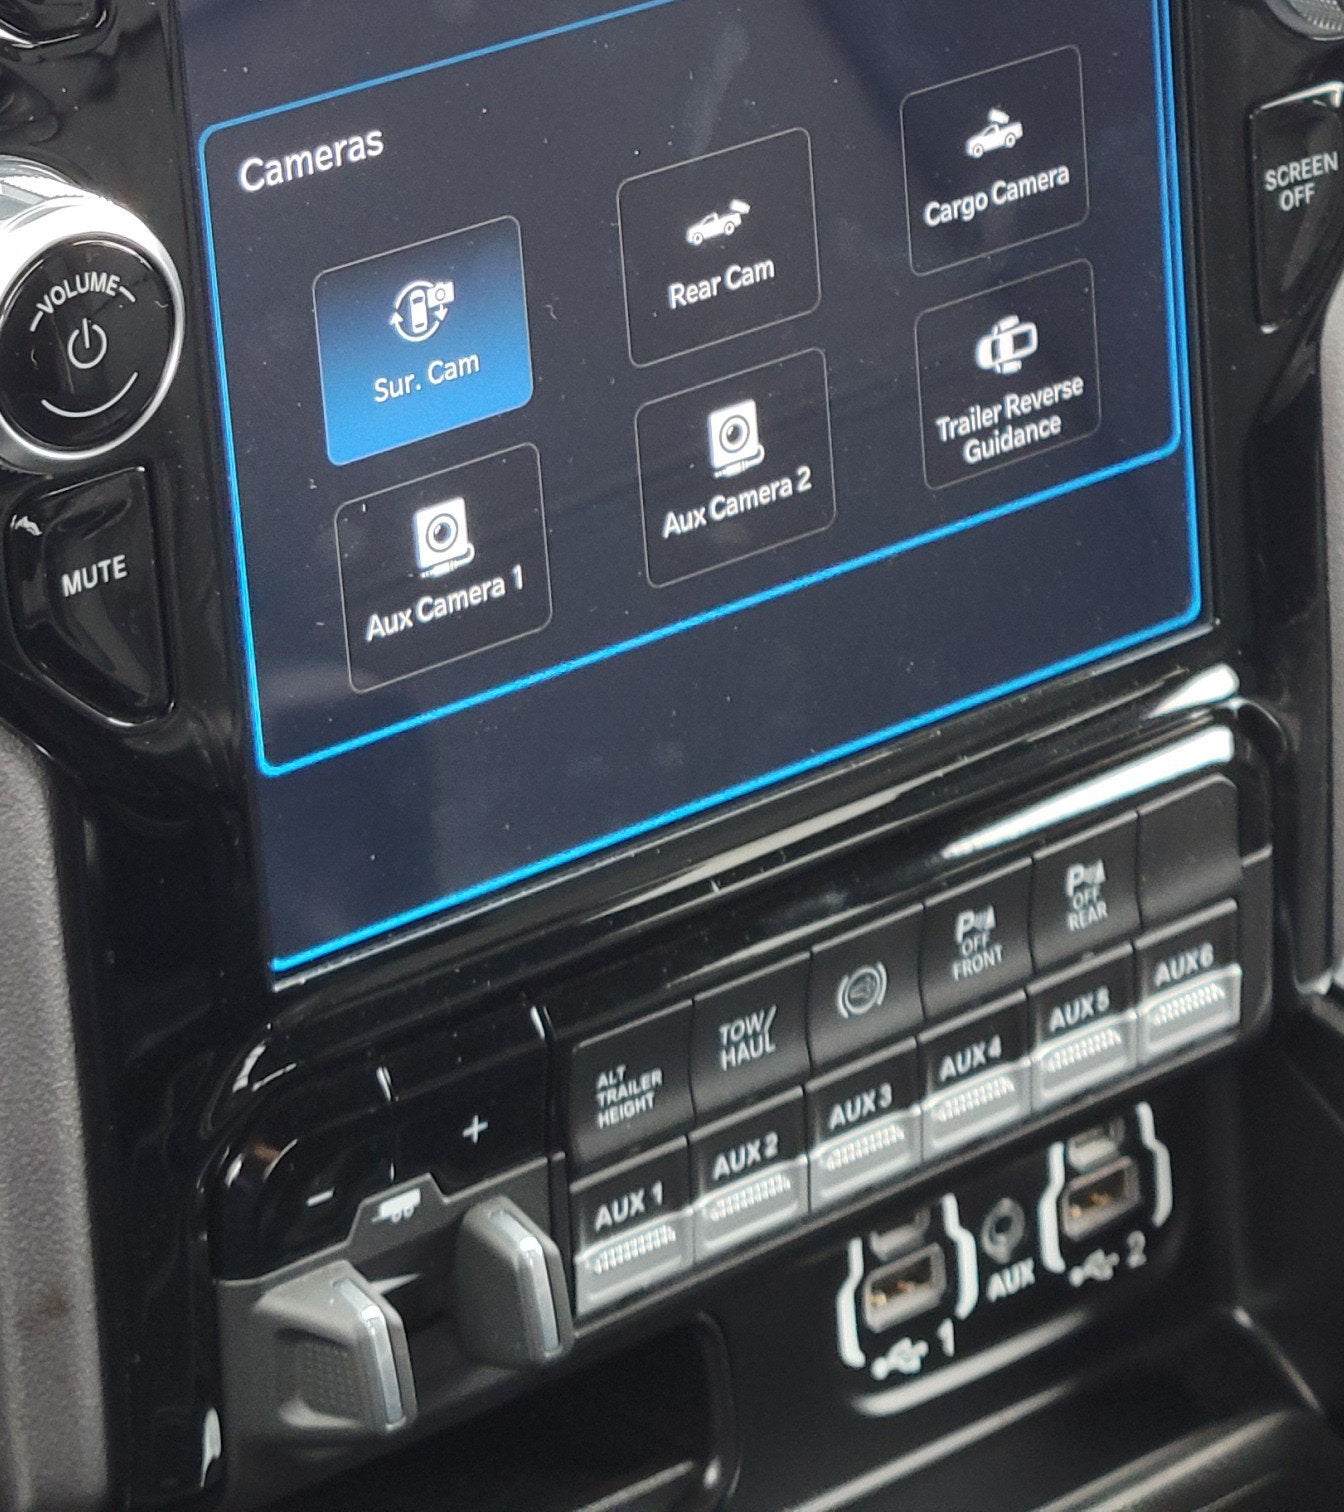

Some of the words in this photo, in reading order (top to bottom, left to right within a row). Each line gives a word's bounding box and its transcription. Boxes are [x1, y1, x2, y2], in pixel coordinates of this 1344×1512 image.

[239, 129, 385, 193] Cameras
[1264, 150, 1340, 192] SCREEN
[923, 190, 989, 228] Cargo
[991, 164, 1070, 207] Camera
[1278, 182, 1316, 212] OFF
[37, 271, 122, 317] VOLUME
[668, 274, 721, 309] Rear
[724, 259, 775, 293] Cam
[373, 371, 423, 404] Sur.
[427, 351, 481, 386] Cam
[936, 402, 1002, 442] Trailer
[1005, 375, 1084, 421] Reverse
[962, 412, 1062, 464] Guidance
[662, 505, 707, 539] Aux
[709, 480, 795, 524] Camera
[796, 465, 812, 492] 2
[61, 555, 128, 598] MUTE
[365, 605, 413, 641] Aux
[416, 578, 506, 625] Camera
[511, 564, 524, 591] 1
[1066, 901, 1108, 932] REAR
[1072, 886, 1102, 911] OFF
[951, 944, 1004, 982] FRONT
[960, 929, 991, 958] OFF
[1154, 953, 1200, 988] AUX
[1048, 997, 1095, 1032] AUX
[720, 1038, 777, 1071] HAUL
[938, 1046, 988, 1082] AUX
[596, 1063, 627, 1089] ALT
[596, 1068, 664, 1109] TRAILER
[597, 1093, 657, 1129] HEIGHT
[828, 1092, 879, 1131] AUX
[711, 1141, 761, 1180] AUX
[594, 1190, 646, 1231] AUX
[652, 1180, 664, 1206] 1
[986, 1256, 1036, 1302] AUX
